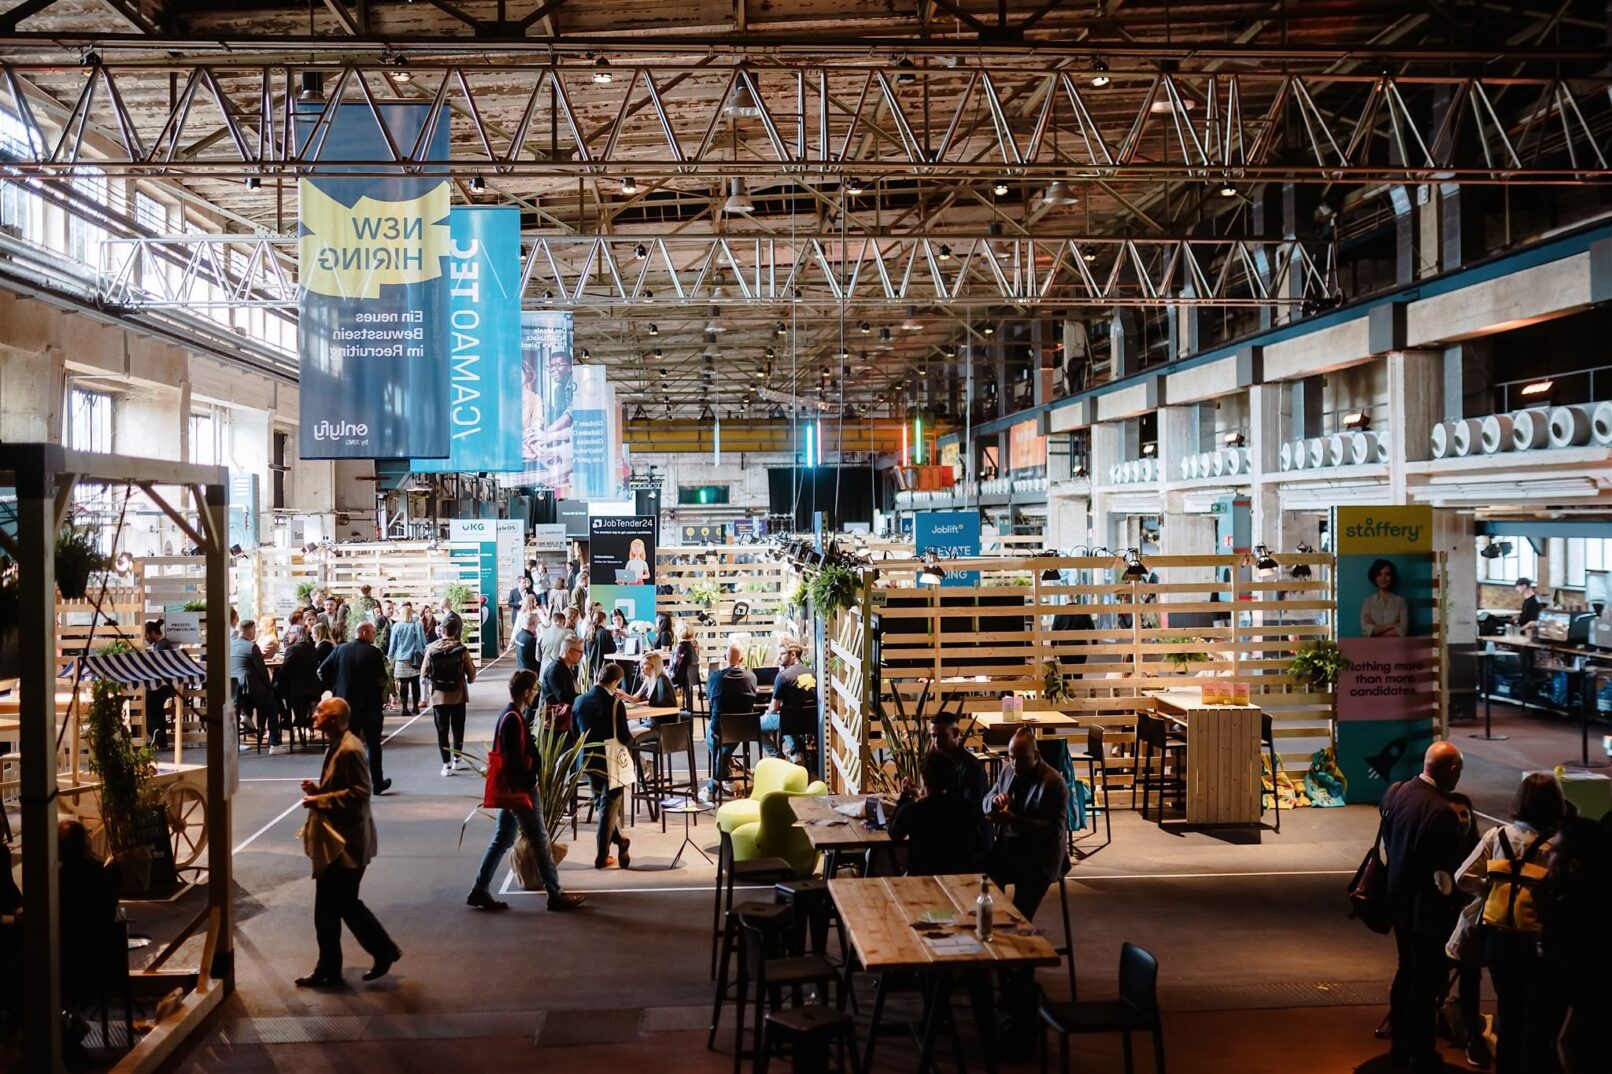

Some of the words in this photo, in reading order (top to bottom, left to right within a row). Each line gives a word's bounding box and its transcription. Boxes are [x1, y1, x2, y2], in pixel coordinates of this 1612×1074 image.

[462, 523, 485, 531] UKG
[602, 518, 653, 528] JobTender24
[931, 524, 959, 534] Joblift
[1394, 661, 1424, 671] more
[1356, 674, 1382, 684] than
[1385, 674, 1415, 684] more
